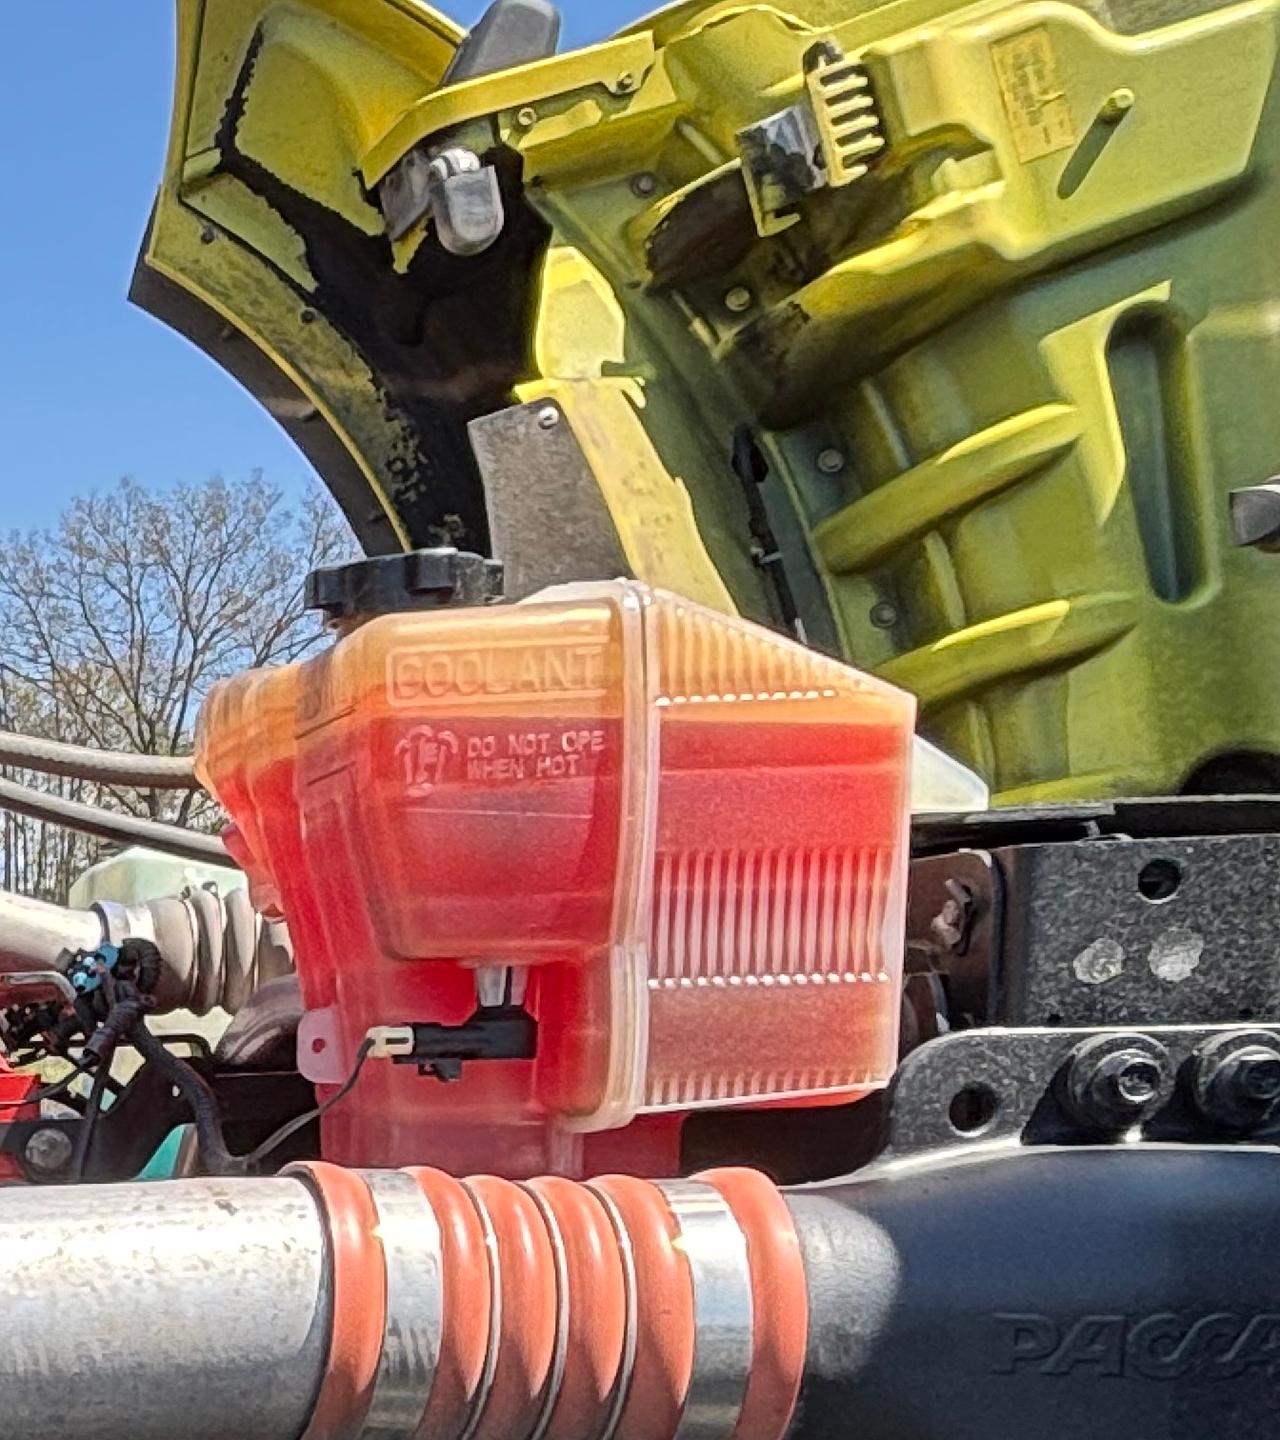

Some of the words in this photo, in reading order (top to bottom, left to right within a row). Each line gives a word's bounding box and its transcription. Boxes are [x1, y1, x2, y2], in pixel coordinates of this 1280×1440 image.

[395, 647, 601, 697] COOLANT
[467, 735, 495, 758] DO
[509, 732, 550, 754] NOT
[467, 756, 524, 780] WHEN
[536, 754, 580, 777] HOT
